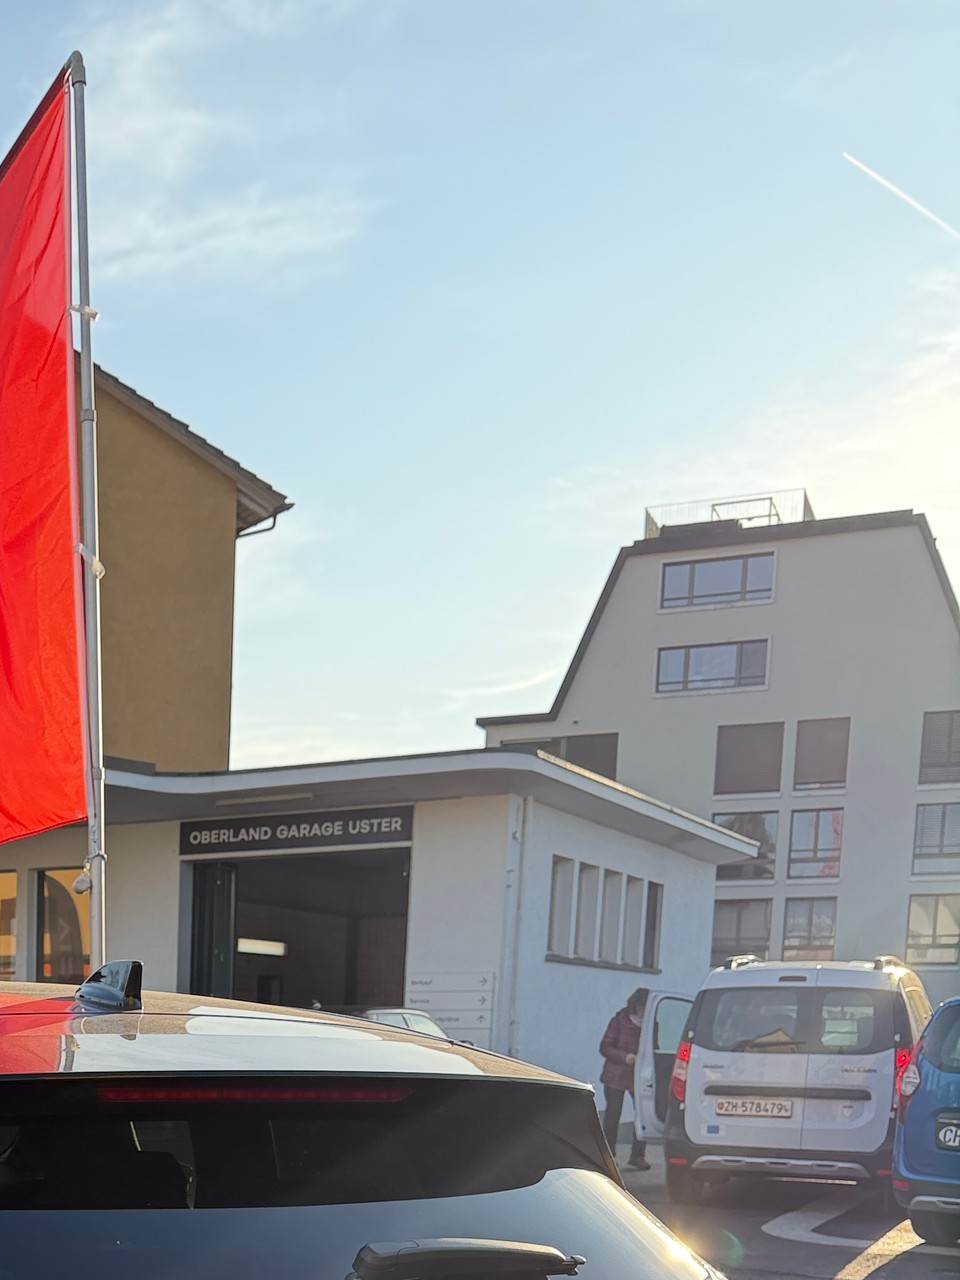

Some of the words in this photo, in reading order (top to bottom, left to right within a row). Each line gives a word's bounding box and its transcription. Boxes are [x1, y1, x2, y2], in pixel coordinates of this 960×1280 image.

[189, 826, 272, 845] OBERLAND
[276, 821, 343, 839] GARAGE
[349, 817, 402, 834] USTER
